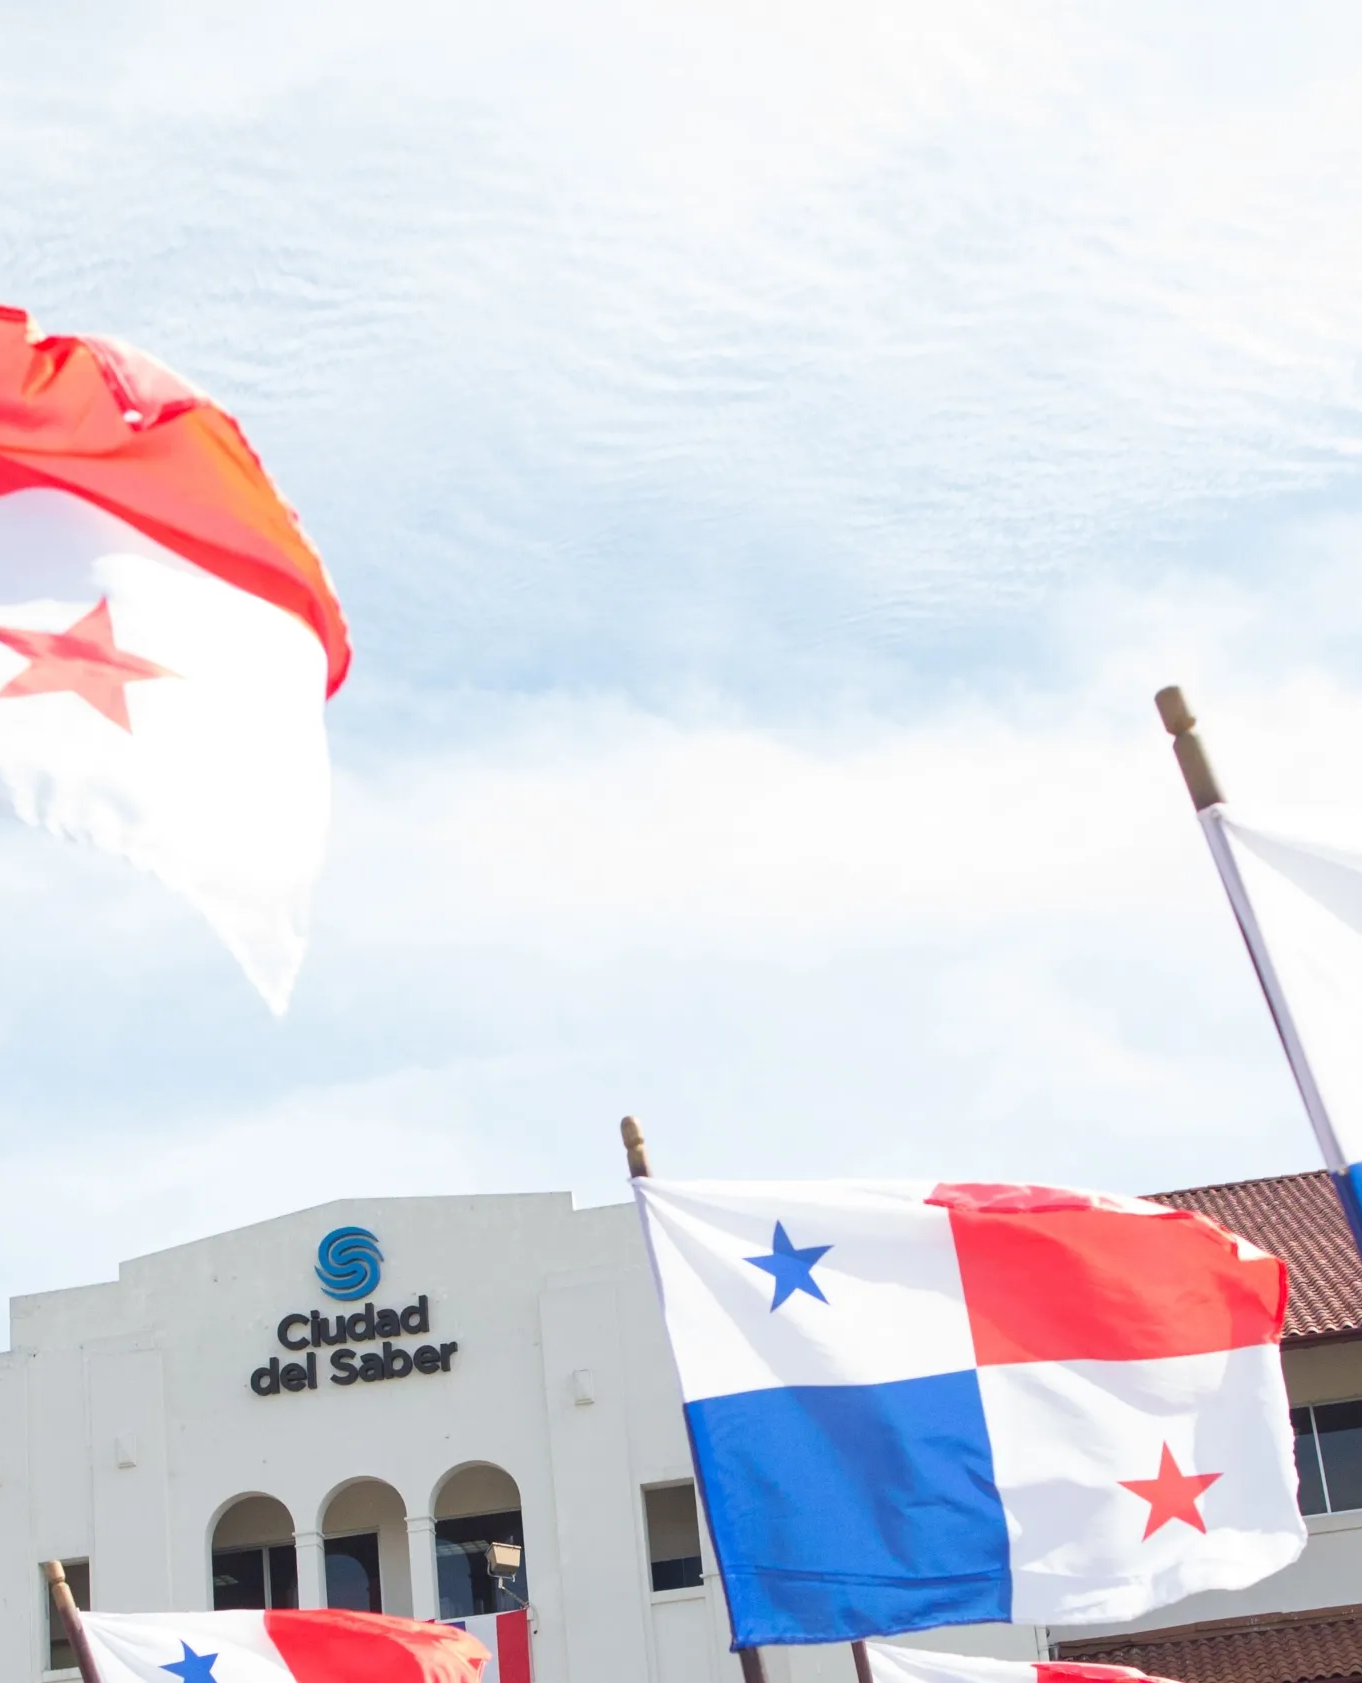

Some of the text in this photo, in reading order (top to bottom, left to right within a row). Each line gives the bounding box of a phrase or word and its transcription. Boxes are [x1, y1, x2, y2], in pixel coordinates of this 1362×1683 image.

[277, 1294, 430, 1351] Ciudad
[250, 1341, 458, 1397] del Saber
